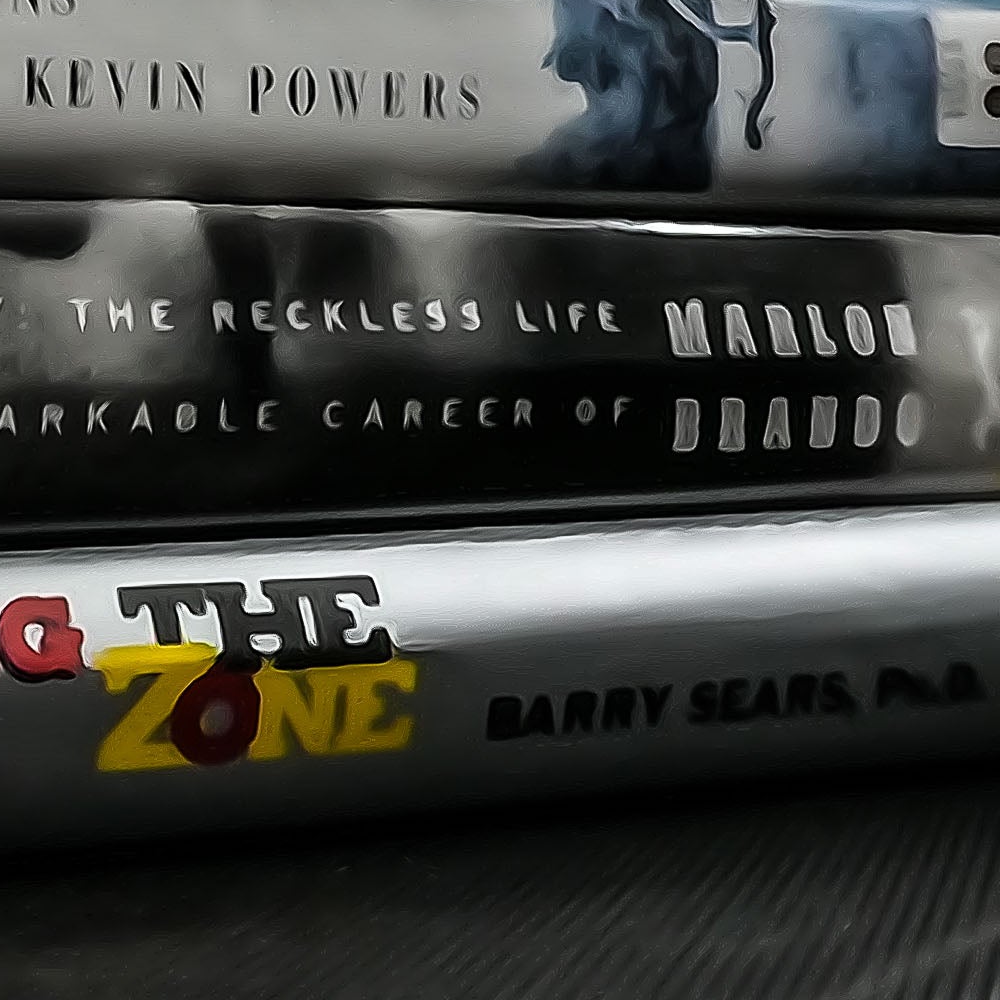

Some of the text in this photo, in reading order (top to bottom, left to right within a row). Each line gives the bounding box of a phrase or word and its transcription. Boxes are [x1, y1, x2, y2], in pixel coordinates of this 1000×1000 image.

[23, 56, 482, 122] KEVIN POWERS
[67, 297, 177, 334] THE
[211, 297, 482, 335] RECKLESS
[514, 298, 623, 335] LIFE
[321, 397, 535, 433] CAREER
[575, 396, 632, 432] OF
[116, 575, 397, 672] THE
[93, 643, 419, 774] ZONE
